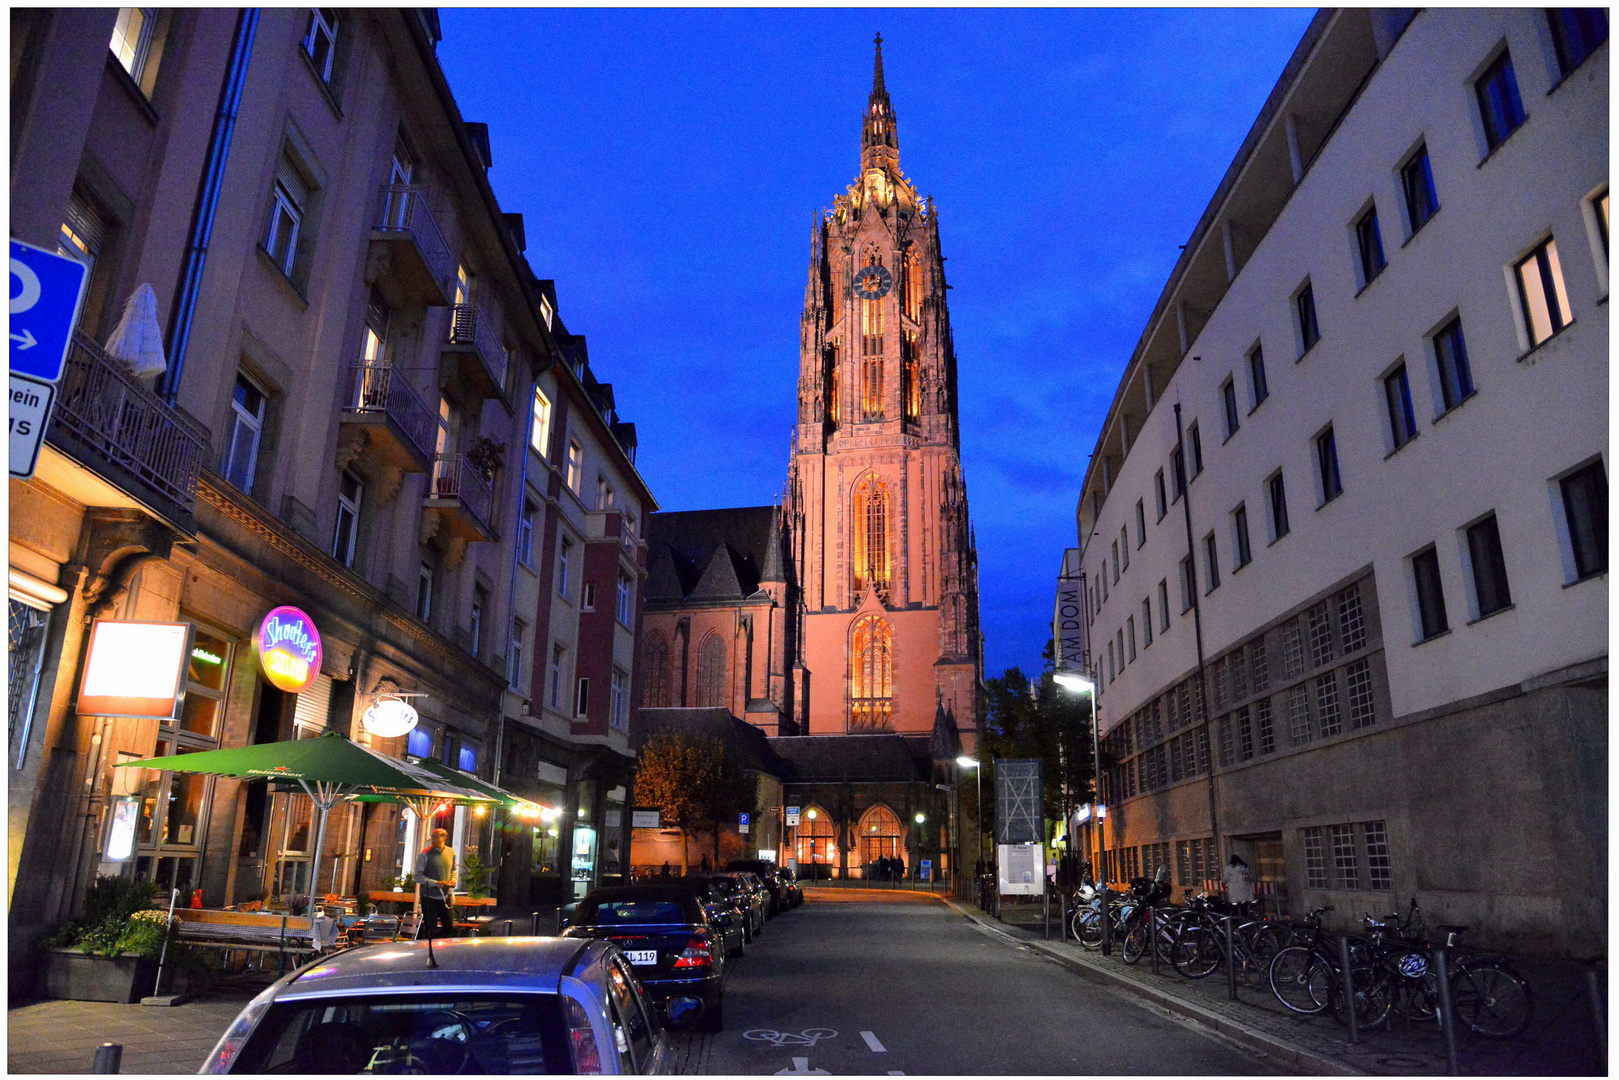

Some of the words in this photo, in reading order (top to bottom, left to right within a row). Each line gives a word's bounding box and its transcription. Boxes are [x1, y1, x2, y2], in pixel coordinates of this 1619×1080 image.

[1060, 589, 1079, 630] DOM
[1063, 636, 1081, 663] AM
[245, 769, 306, 777] Heineken
[637, 951, 655, 962] 119
